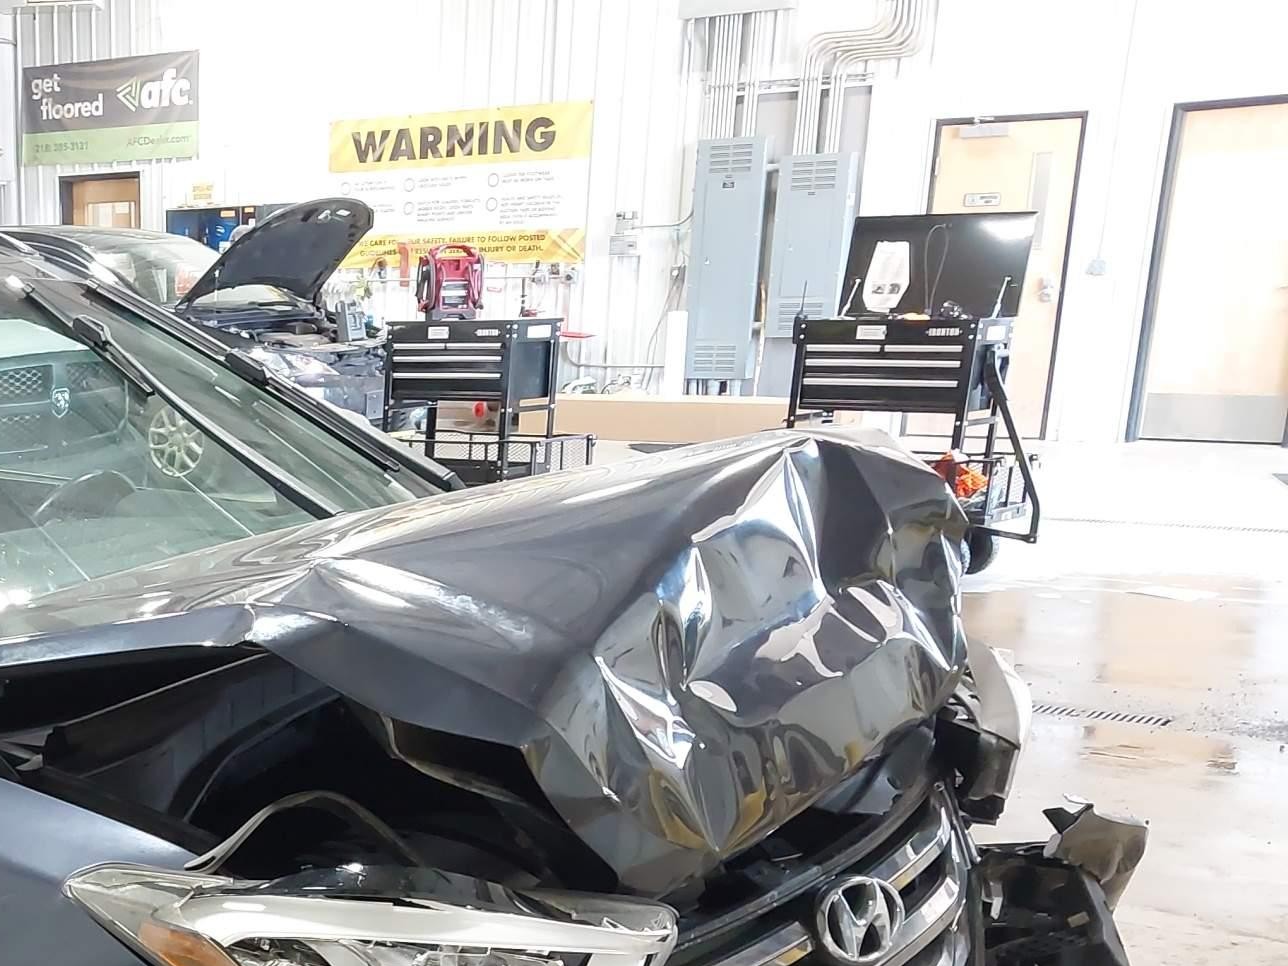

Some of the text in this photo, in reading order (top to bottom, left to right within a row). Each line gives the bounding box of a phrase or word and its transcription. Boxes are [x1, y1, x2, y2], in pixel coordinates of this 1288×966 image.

[31, 73, 61, 100] get
[40, 93, 104, 120] floored
[351, 116, 556, 164] WARNING
[488, 235, 517, 243] FOLLOW
[518, 234, 546, 242] POSTED
